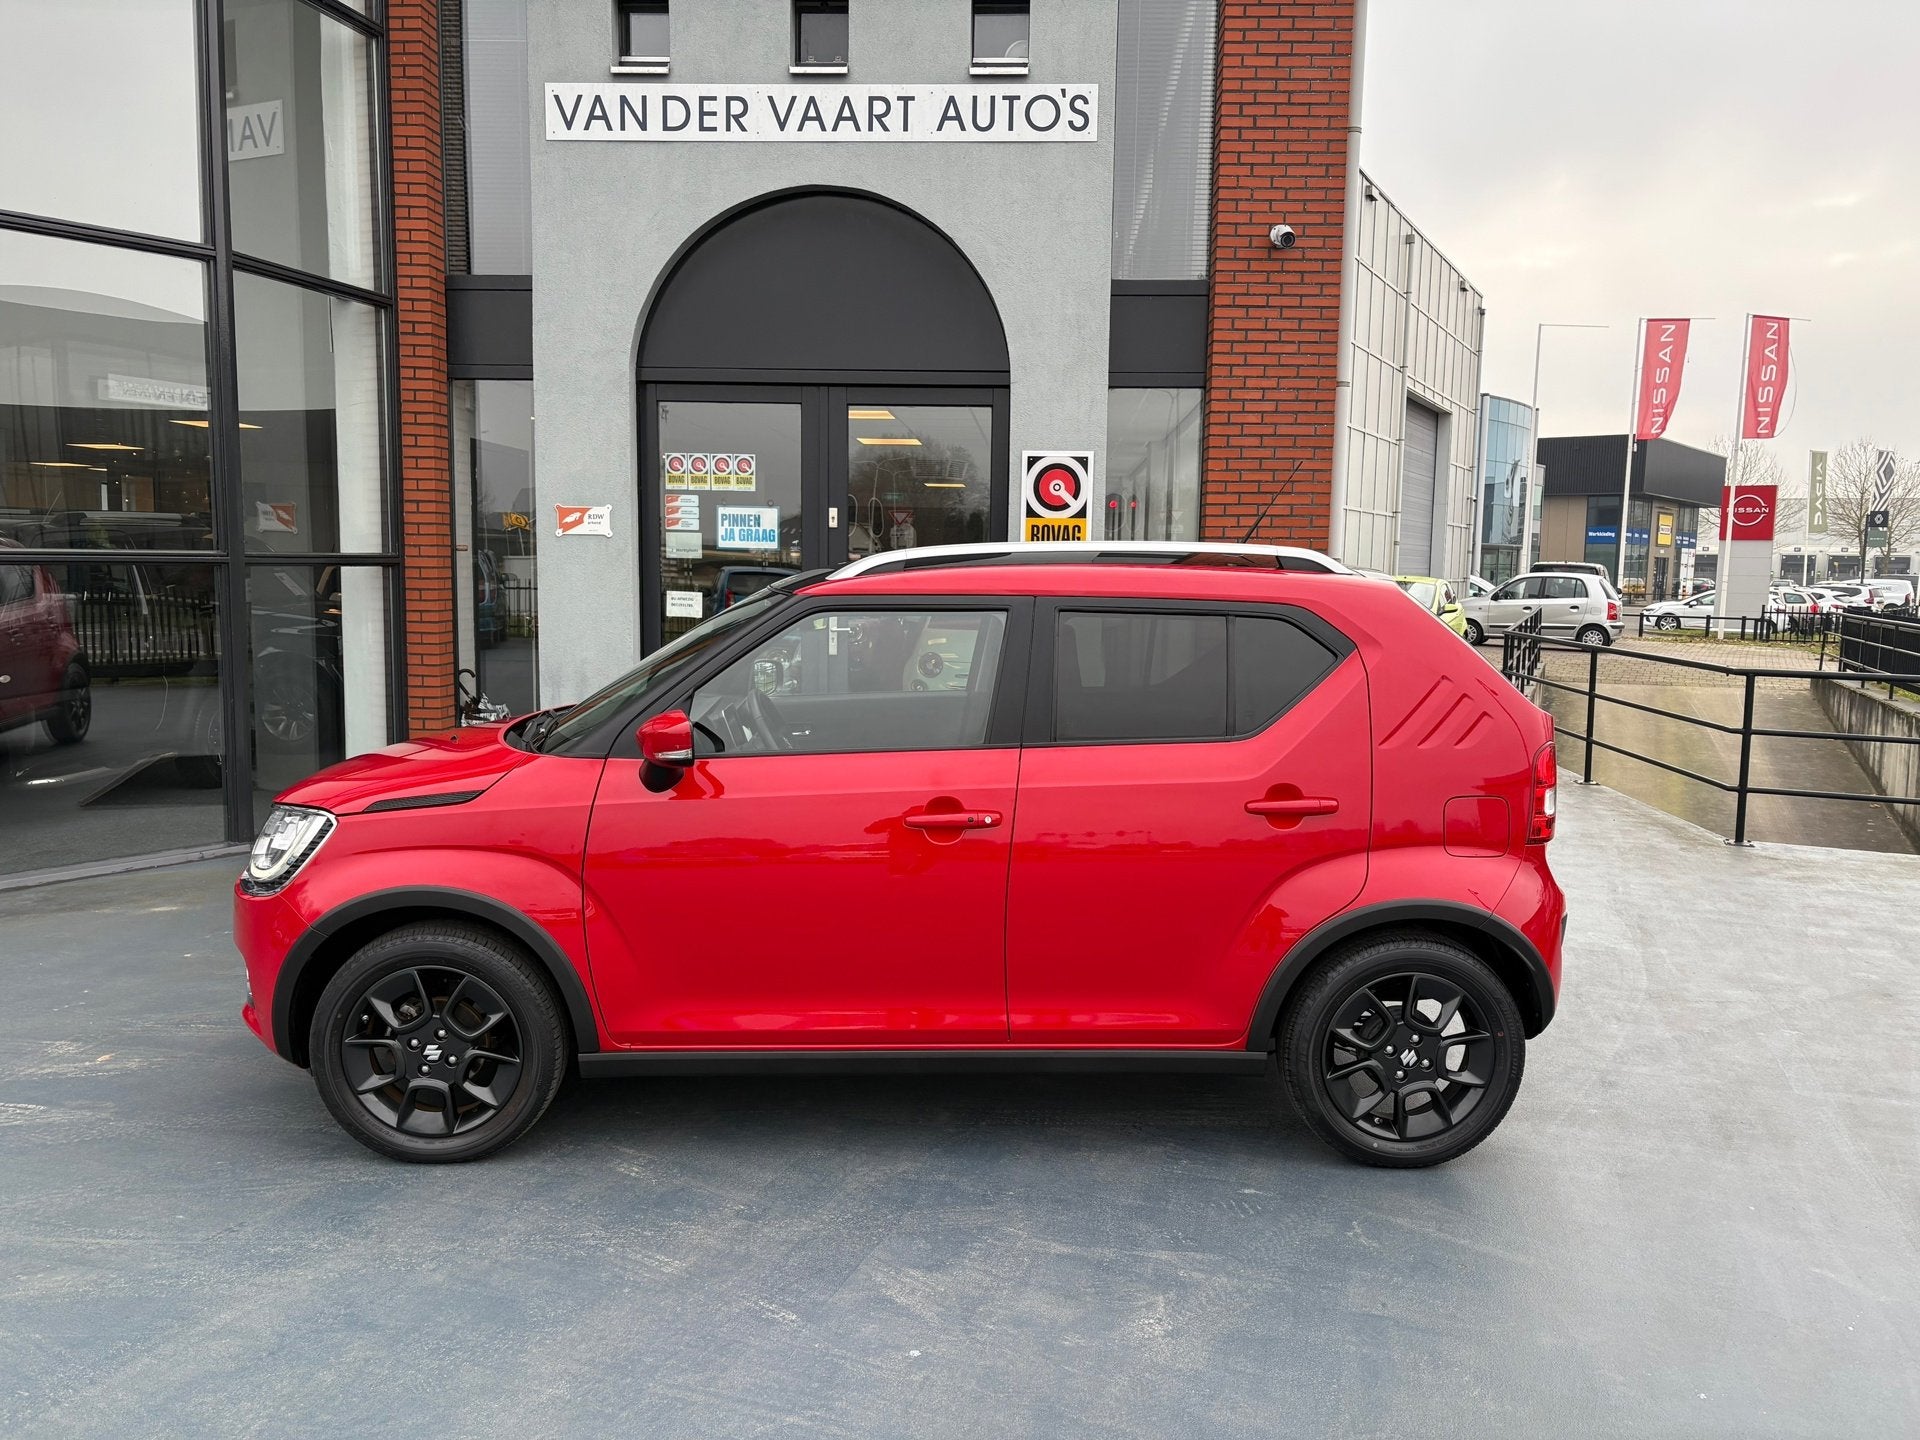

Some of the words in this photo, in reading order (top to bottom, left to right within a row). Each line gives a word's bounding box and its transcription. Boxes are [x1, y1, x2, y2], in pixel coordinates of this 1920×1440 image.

[553, 94, 648, 132] VAN
[661, 94, 750, 132] DER
[767, 94, 917, 132] VAART
[937, 88, 1091, 133] AUTO'S
[1650, 325, 1676, 434] NISSAN
[1757, 322, 1779, 434] NISSAN
[721, 513, 761, 527] PINNEN
[721, 529, 735, 542] JA
[739, 529, 776, 543] GRAAG
